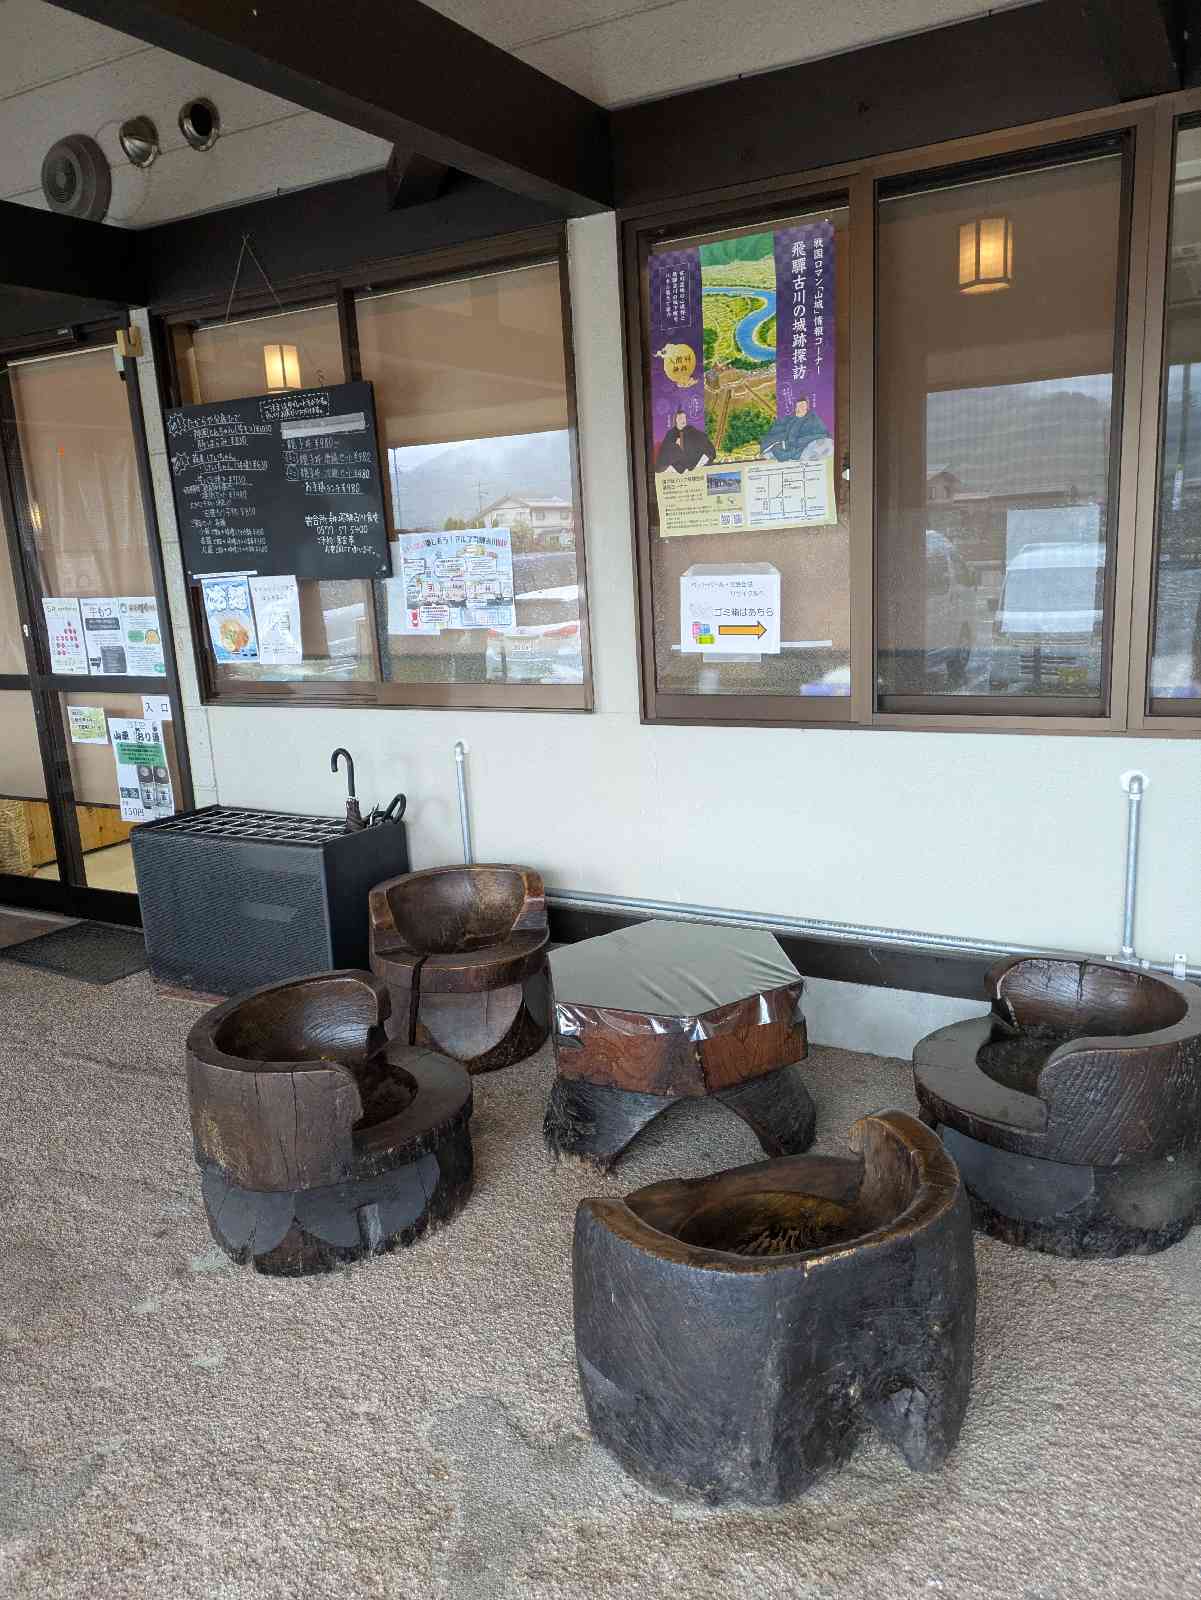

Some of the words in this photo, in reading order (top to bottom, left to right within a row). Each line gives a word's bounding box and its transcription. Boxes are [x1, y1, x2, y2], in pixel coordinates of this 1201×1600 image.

[711, 607, 775, 617] ゴミ箱はあちら
